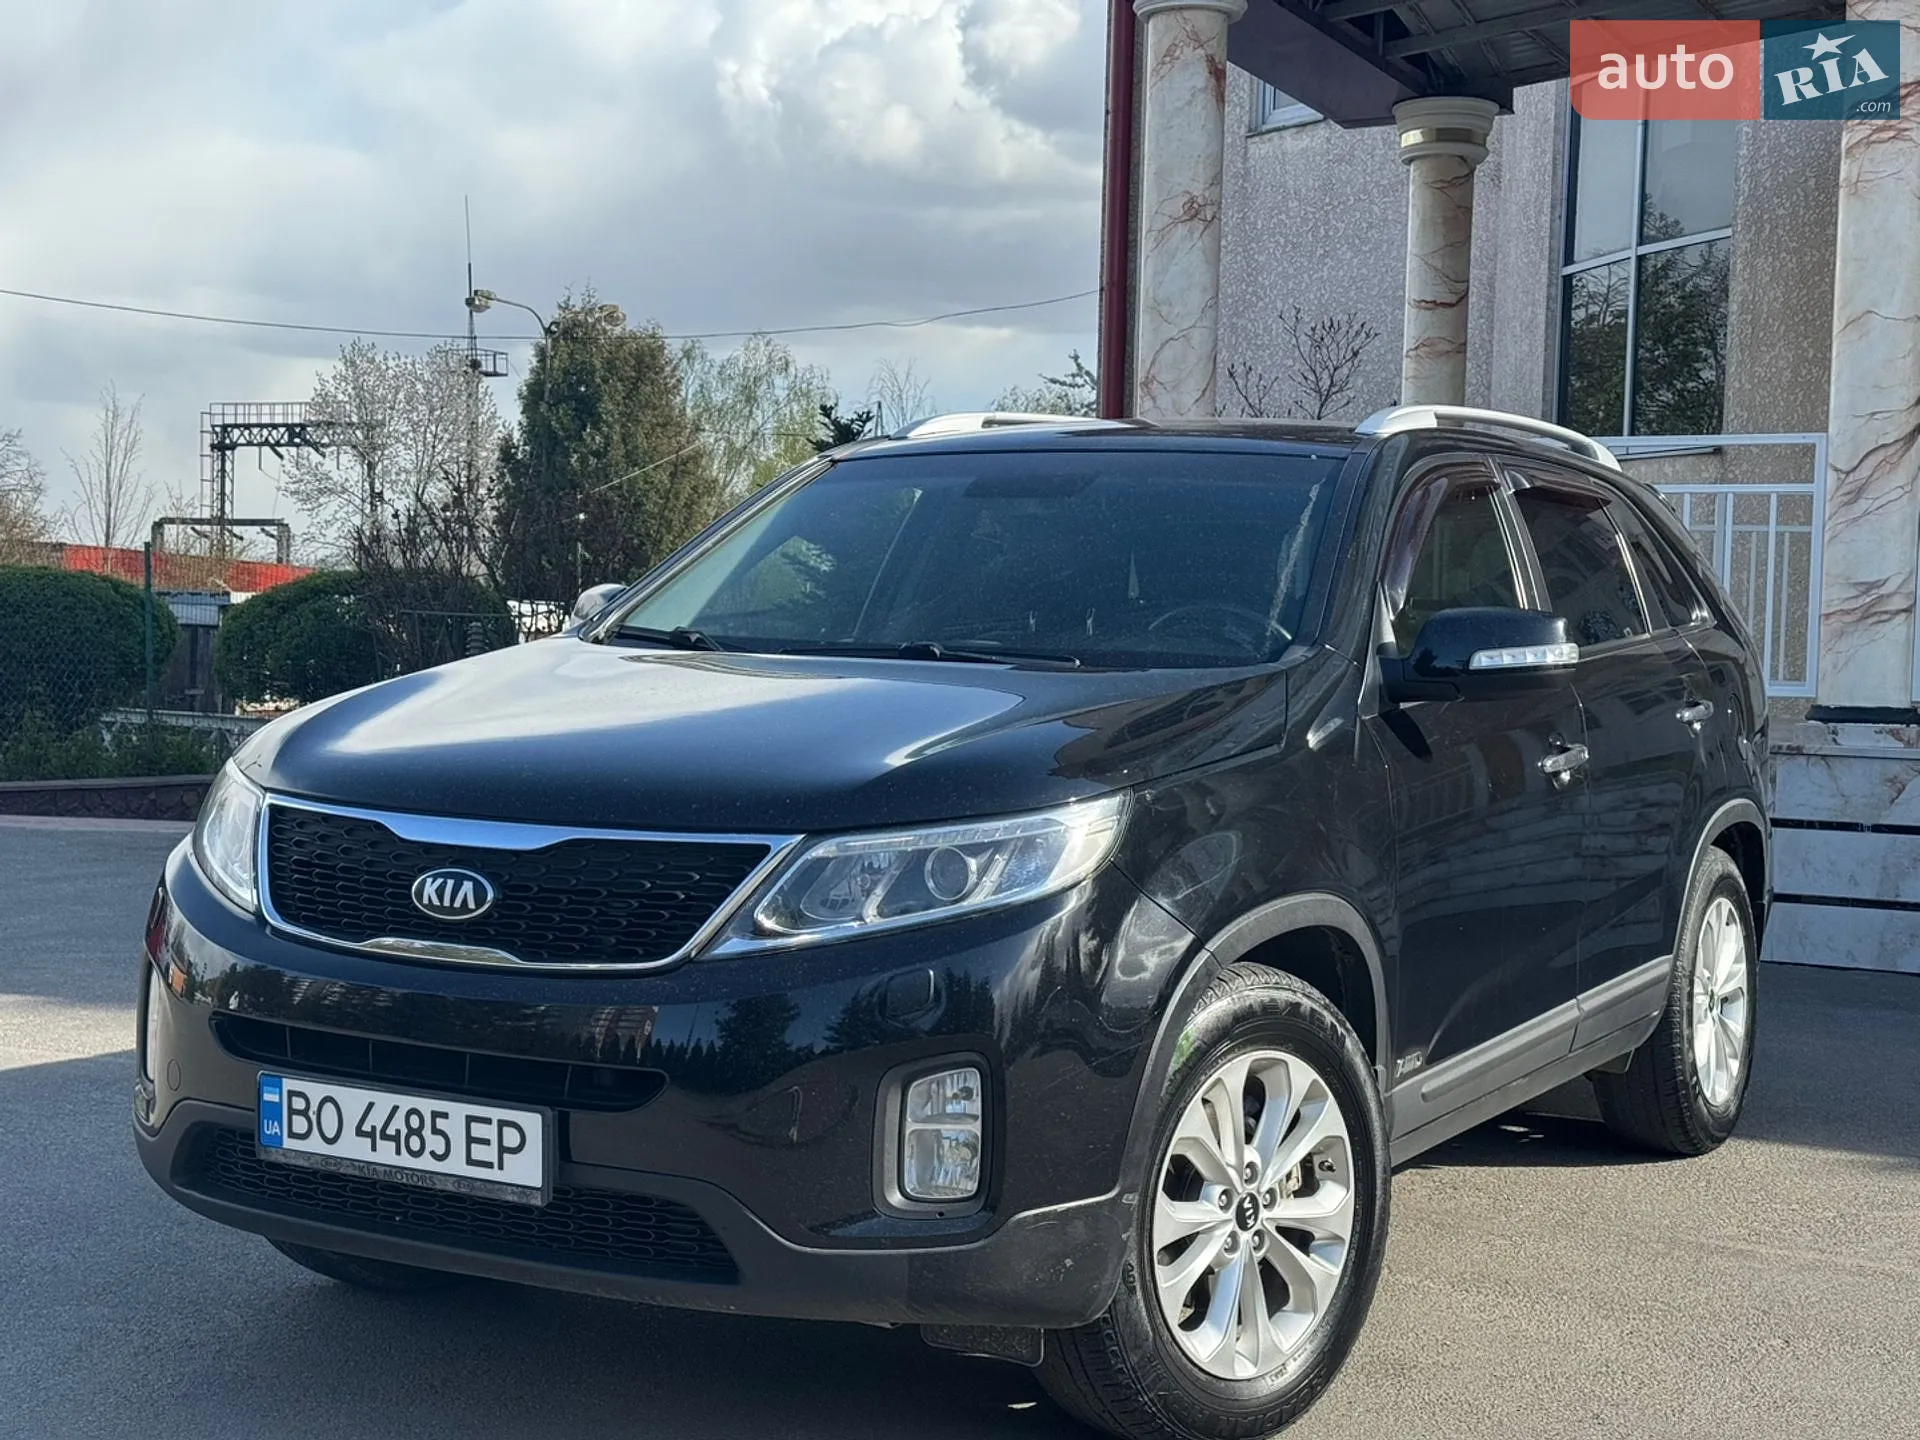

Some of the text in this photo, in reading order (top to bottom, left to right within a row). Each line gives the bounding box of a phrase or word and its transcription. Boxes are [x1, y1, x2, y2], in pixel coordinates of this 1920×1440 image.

[422, 877, 476, 909] KIA
[263, 1119, 281, 1136] UA
[286, 1089, 527, 1171] BO 4485 EP
[358, 1162, 379, 1177] KIA
[382, 1167, 437, 1187] MOTORS
[1243, 1195, 1256, 1229] KIA
